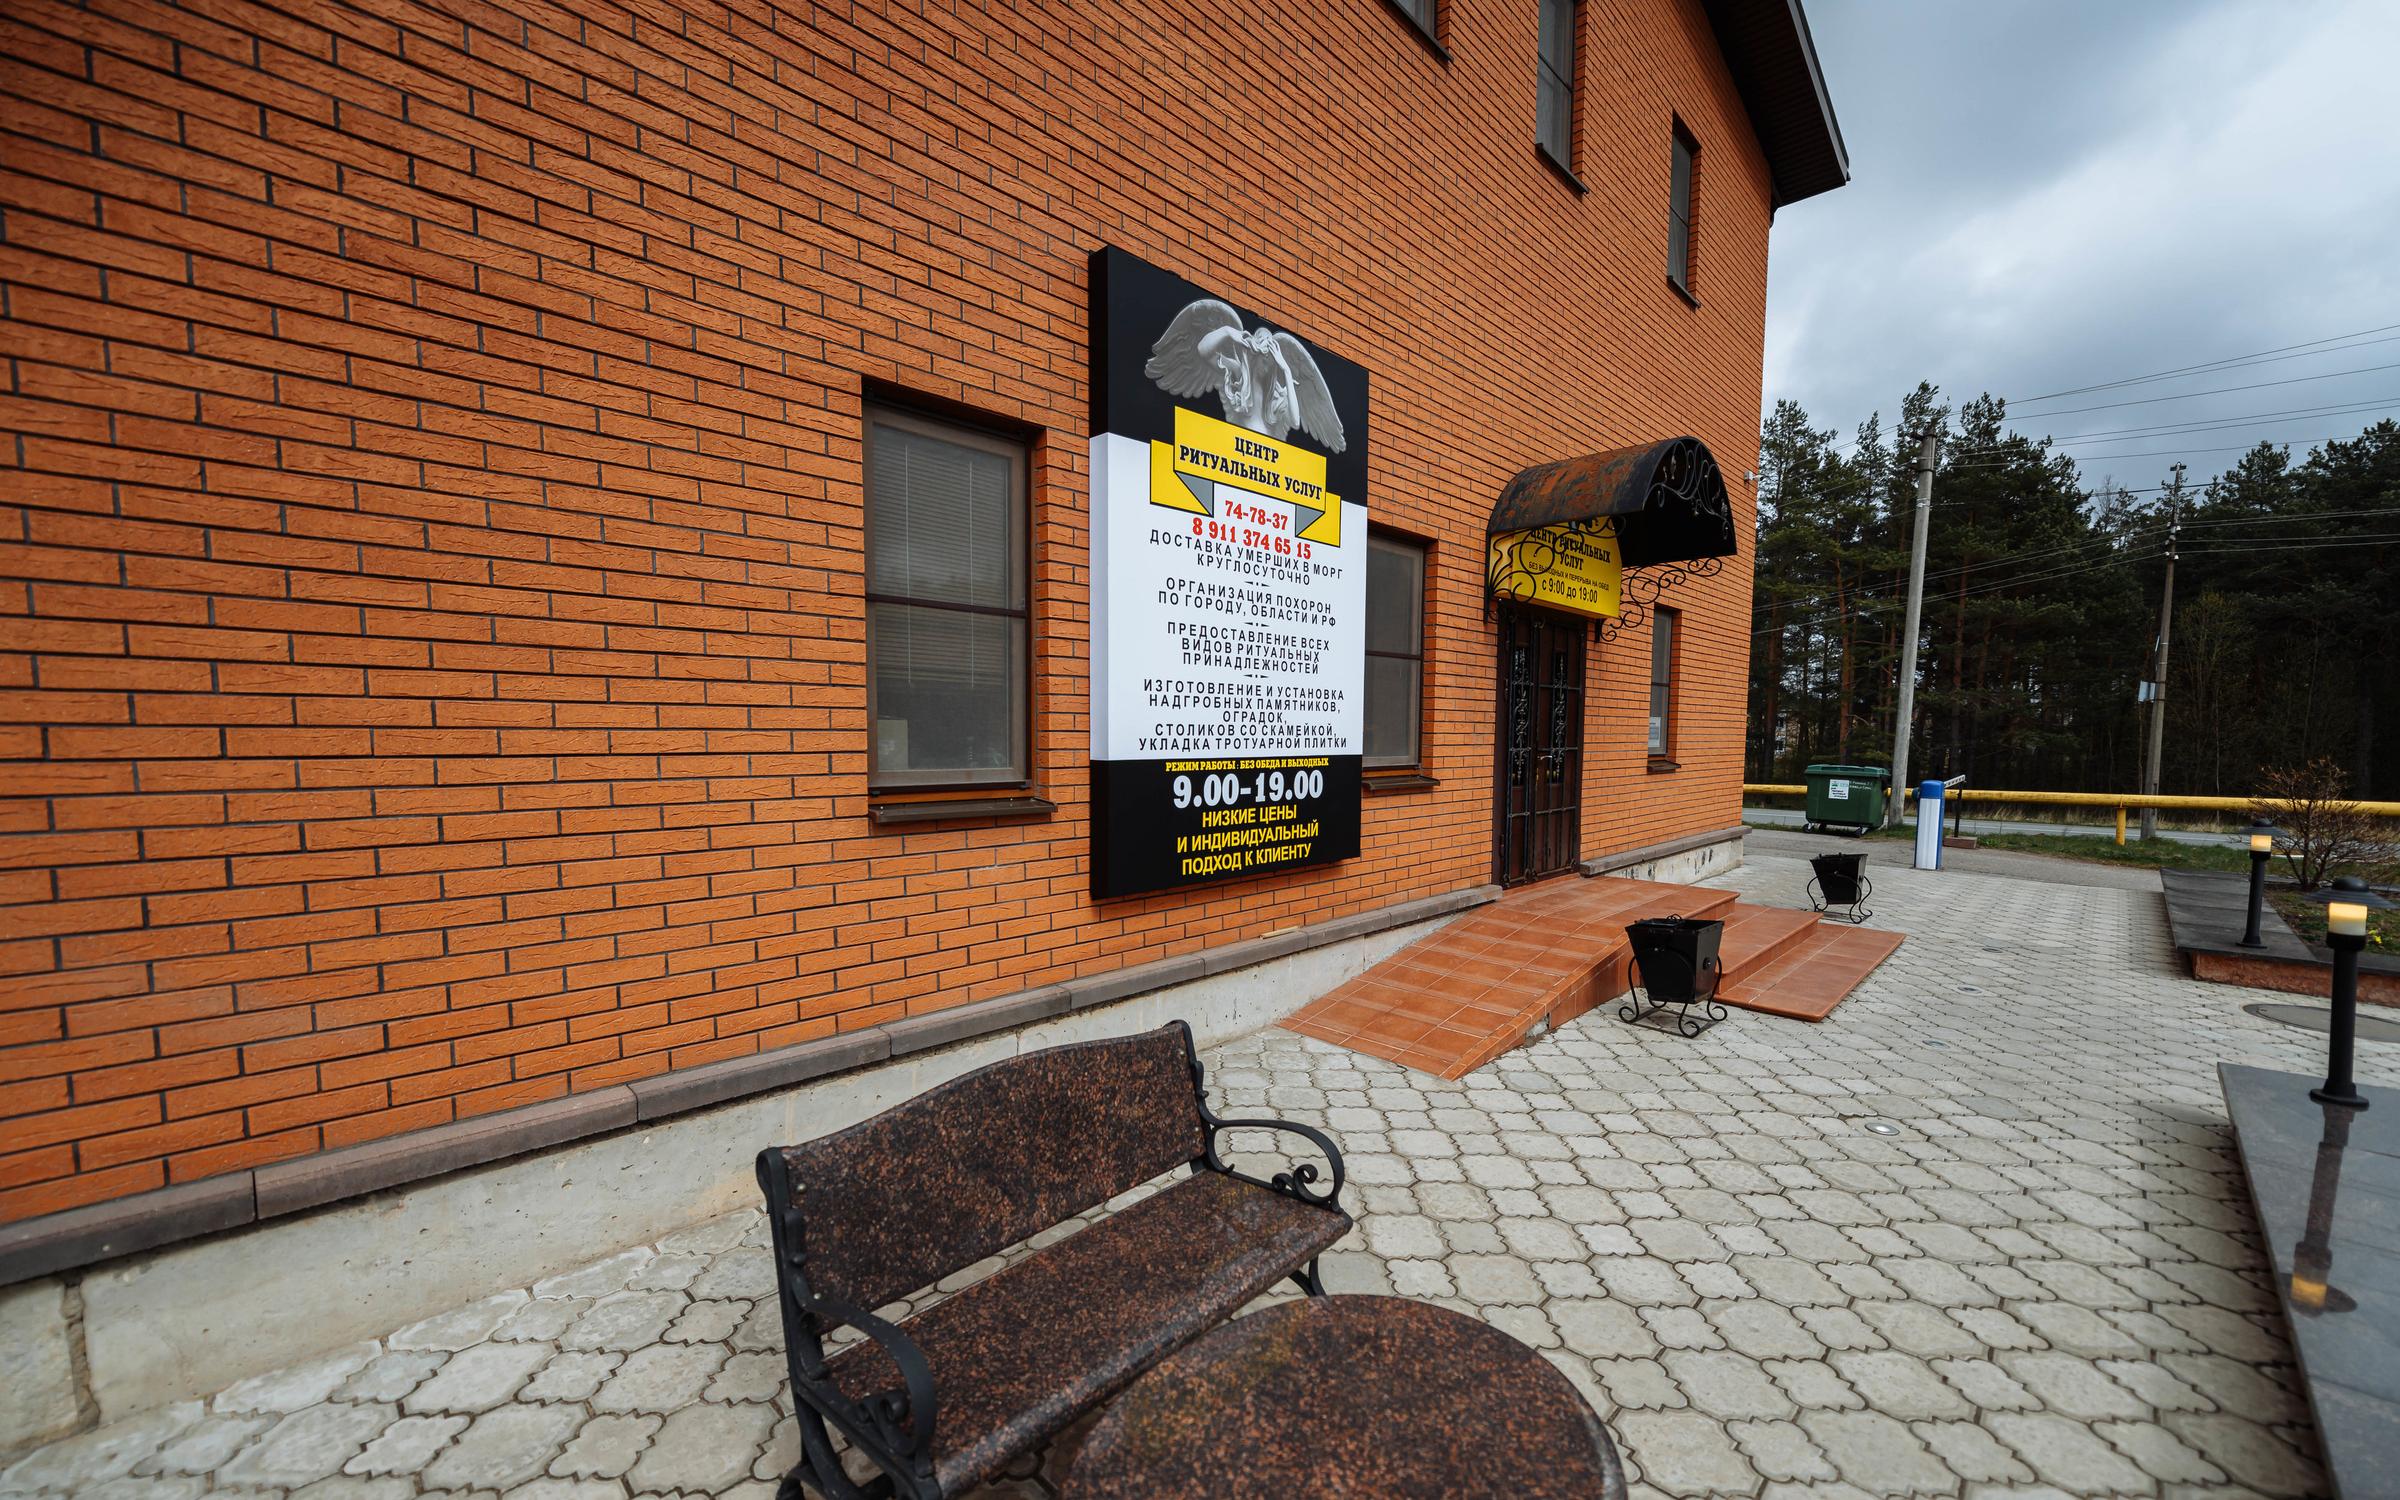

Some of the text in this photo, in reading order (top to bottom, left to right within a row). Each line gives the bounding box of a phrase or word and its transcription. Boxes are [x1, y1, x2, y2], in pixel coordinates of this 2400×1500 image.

[1234, 436, 1279, 464] ЦЕНТР
[1179, 445, 1323, 501] РИТУАЛЬНЫХ УСЛУГ
[1225, 500, 1289, 531] 74-78-37
[1192, 518, 1312, 560] 8 911 374 65 15
[1150, 529, 1343, 579] ДОСТАВКА УМЕРШИХ В МОРГ
[1528, 561, 1538, 570] БЕЗ
[1560, 552, 1584, 571] УСЛУГ
[1197, 552, 1311, 586] КРУГЛОСУТОЧНО
[1166, 577, 1331, 614] ОРГАНИЗАЦИЯ ПОХОРОН
[1548, 577, 1565, 596] 9:00
[1579, 586, 1598, 604] 19:00
[1158, 591, 1336, 627] ПО ГОРОДУ, ОБЛАСТИ И РФ
[1167, 621, 1330, 651] ПРЕДОСТАВЛЕНИЕ ВСЕХ
[1181, 638, 1320, 663] ВИДОВ РИТУАЛЬНЫХ
[1183, 652, 1319, 675] ПРИНАДЛЕЖНОСТЕЙ
[1144, 679, 1344, 701] ИЗГОТОВЛЕНИЕ И УСТАНОВКА
[1149, 694, 1341, 714] НАДГРОБНЫХ ПАМЯТНИКОВ,
[1155, 722, 1337, 738] СТОЛИКОВ СО СКАМЕЙКОЙ,
[1223, 711, 1287, 725] ОГРАДОК,
[1139, 735, 1347, 752] УКЛАДКА ТРОТУАРНОЙ ПЛИТКИ
[1165, 762, 1199, 772] РЕЖИМ
[1240, 760, 1255, 769] БЕЗ
[1256, 759, 1281, 769] ОБЕДА
[1287, 758, 1329, 767] ВЫХОДНЫХ
[1173, 769, 1324, 808] 9.00-19.00
[1202, 804, 1297, 828] НИЗКИЕ ЦЕНЫ
[1177, 819, 1319, 853] И ИНДИВИДУАЛЬНЫЙ
[1182, 843, 1312, 876] ПОДХОД К КЛИЕНТУ
